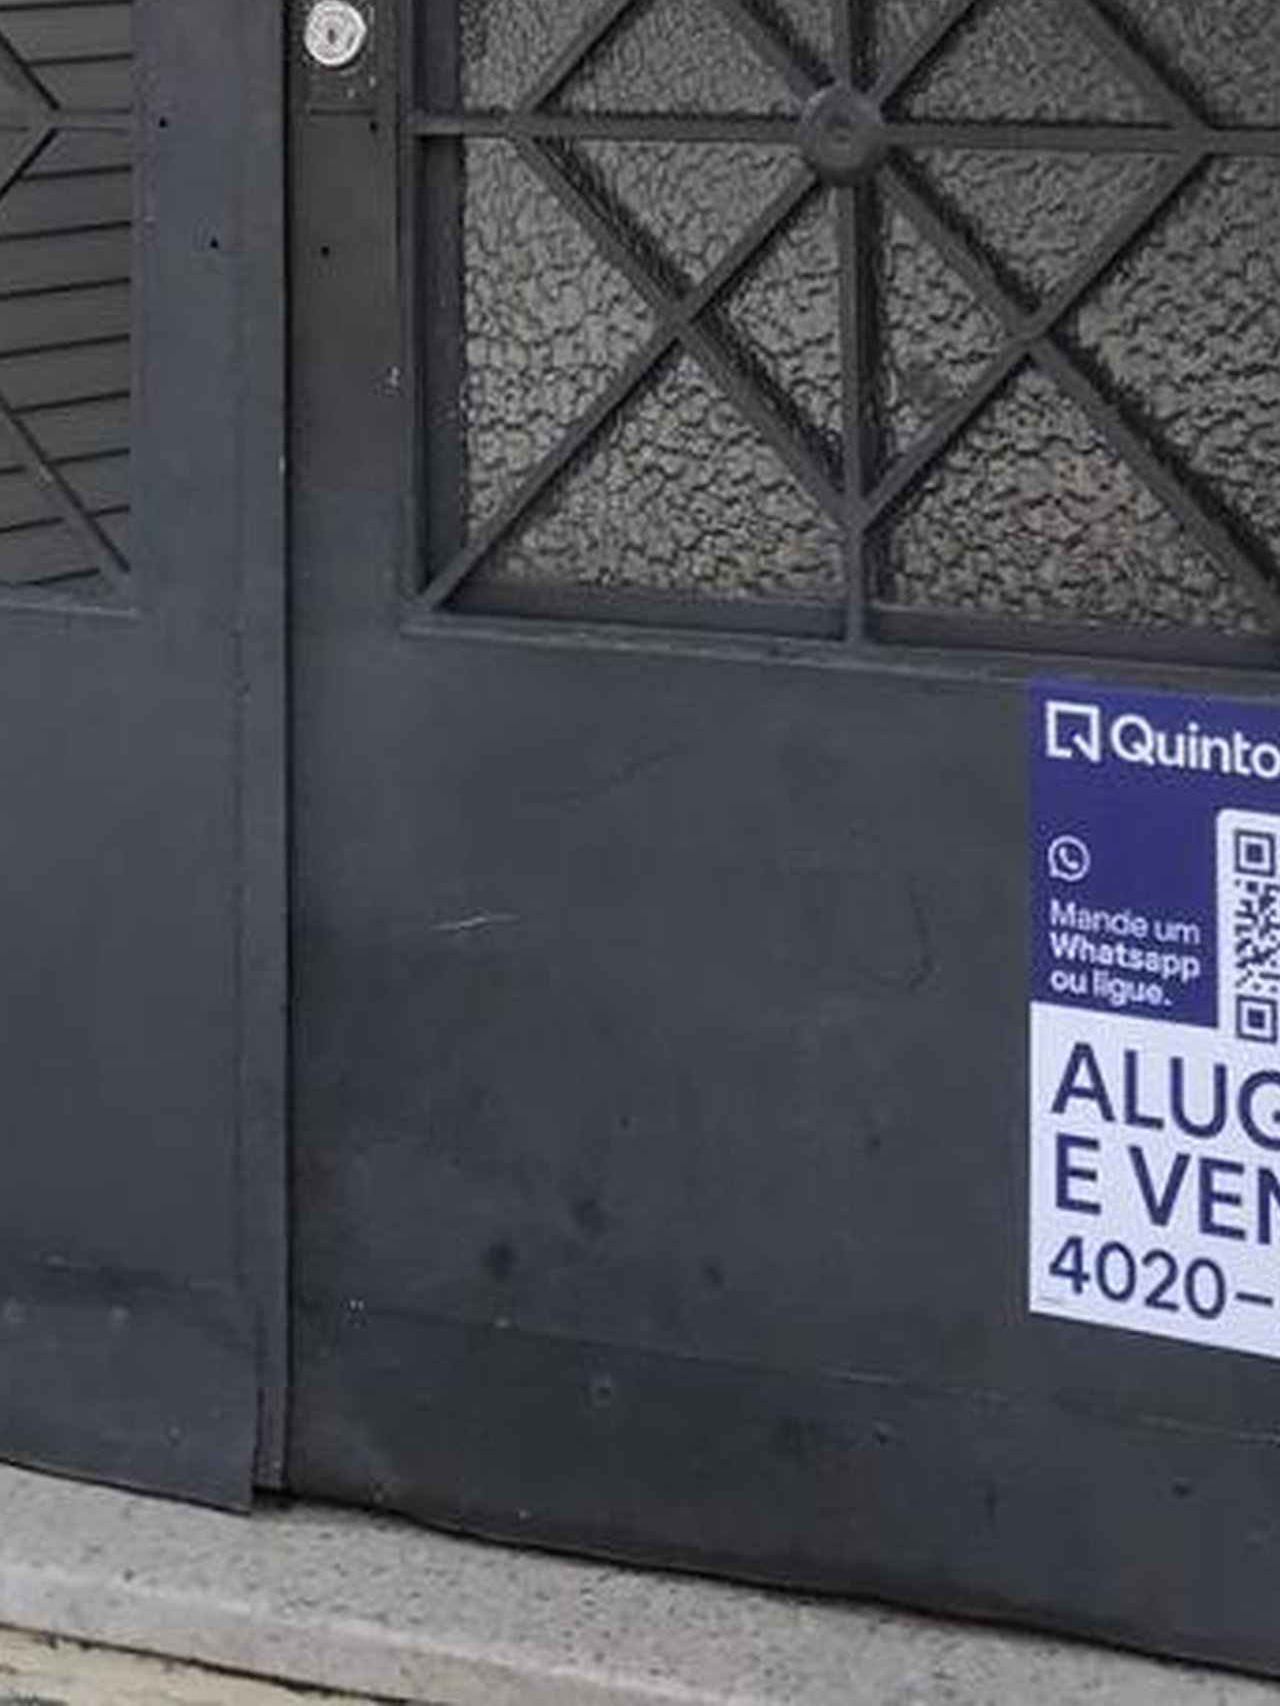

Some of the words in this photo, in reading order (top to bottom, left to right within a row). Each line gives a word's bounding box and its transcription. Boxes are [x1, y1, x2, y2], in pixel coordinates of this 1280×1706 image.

[1049, 899, 1149, 939] Mande
[1154, 915, 1201, 945] um
[1049, 932, 1201, 982] Whatsapp
[1050, 969, 1088, 994] ou
[1093, 971, 1173, 1007] ligue.
[1055, 1131, 1102, 1216] E
